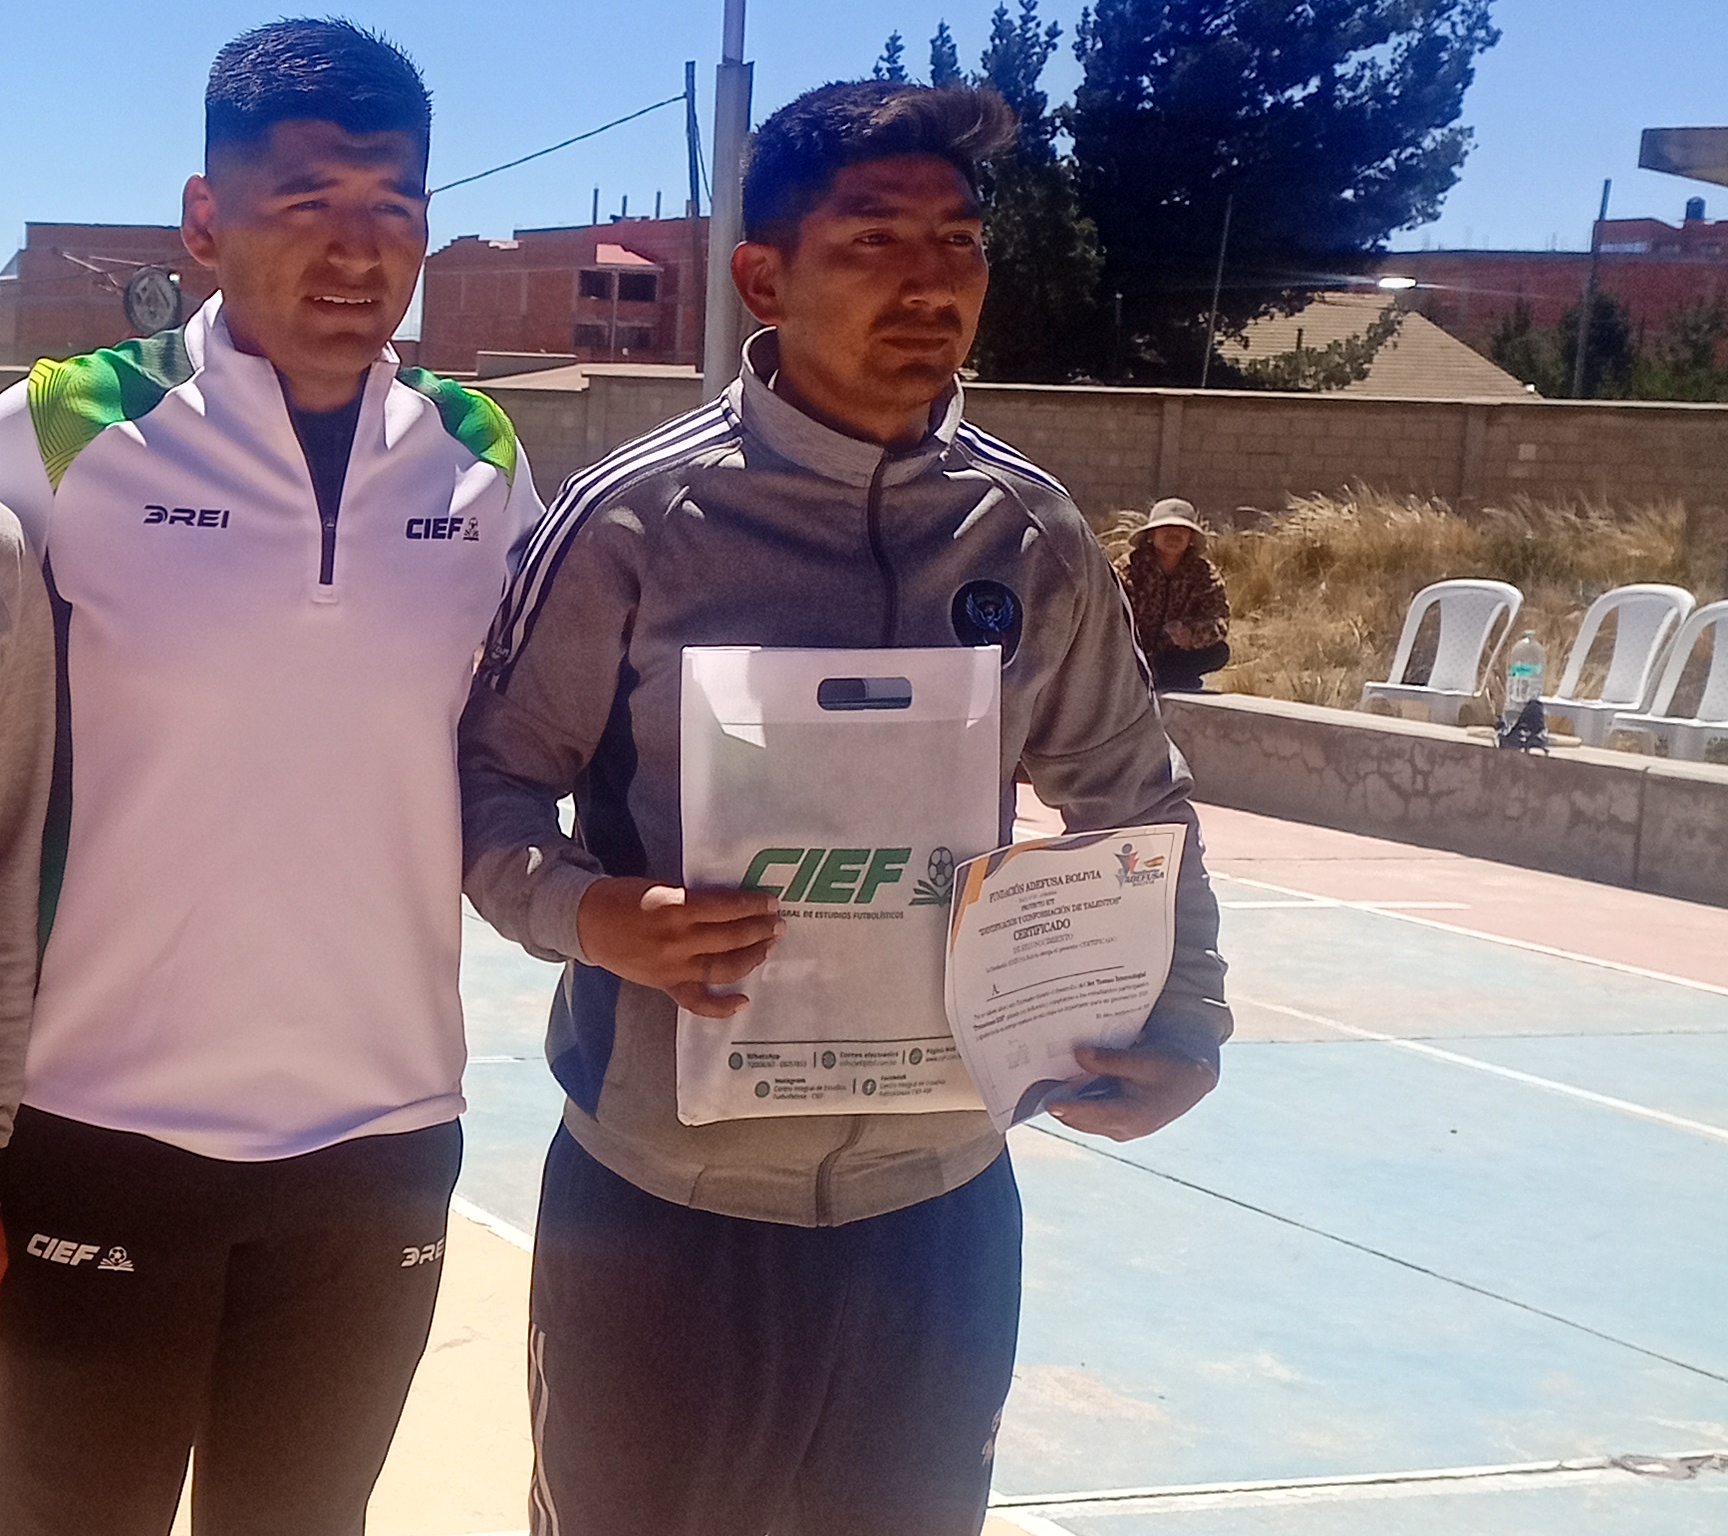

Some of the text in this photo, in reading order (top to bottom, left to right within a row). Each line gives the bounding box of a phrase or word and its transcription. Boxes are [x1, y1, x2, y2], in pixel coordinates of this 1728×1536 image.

[405, 517, 464, 540] CIEF
[739, 848, 912, 904] CIEF
[1065, 870, 1102, 884] BOLIVIA
[803, 910, 813, 918] DE
[815, 911, 851, 920] ESTUDIOS
[852, 910, 904, 920] FUTBOLÍSTICOS
[1013, 918, 1071, 940] CERTIFICADO
[26, 1233, 100, 1266] CIEF
